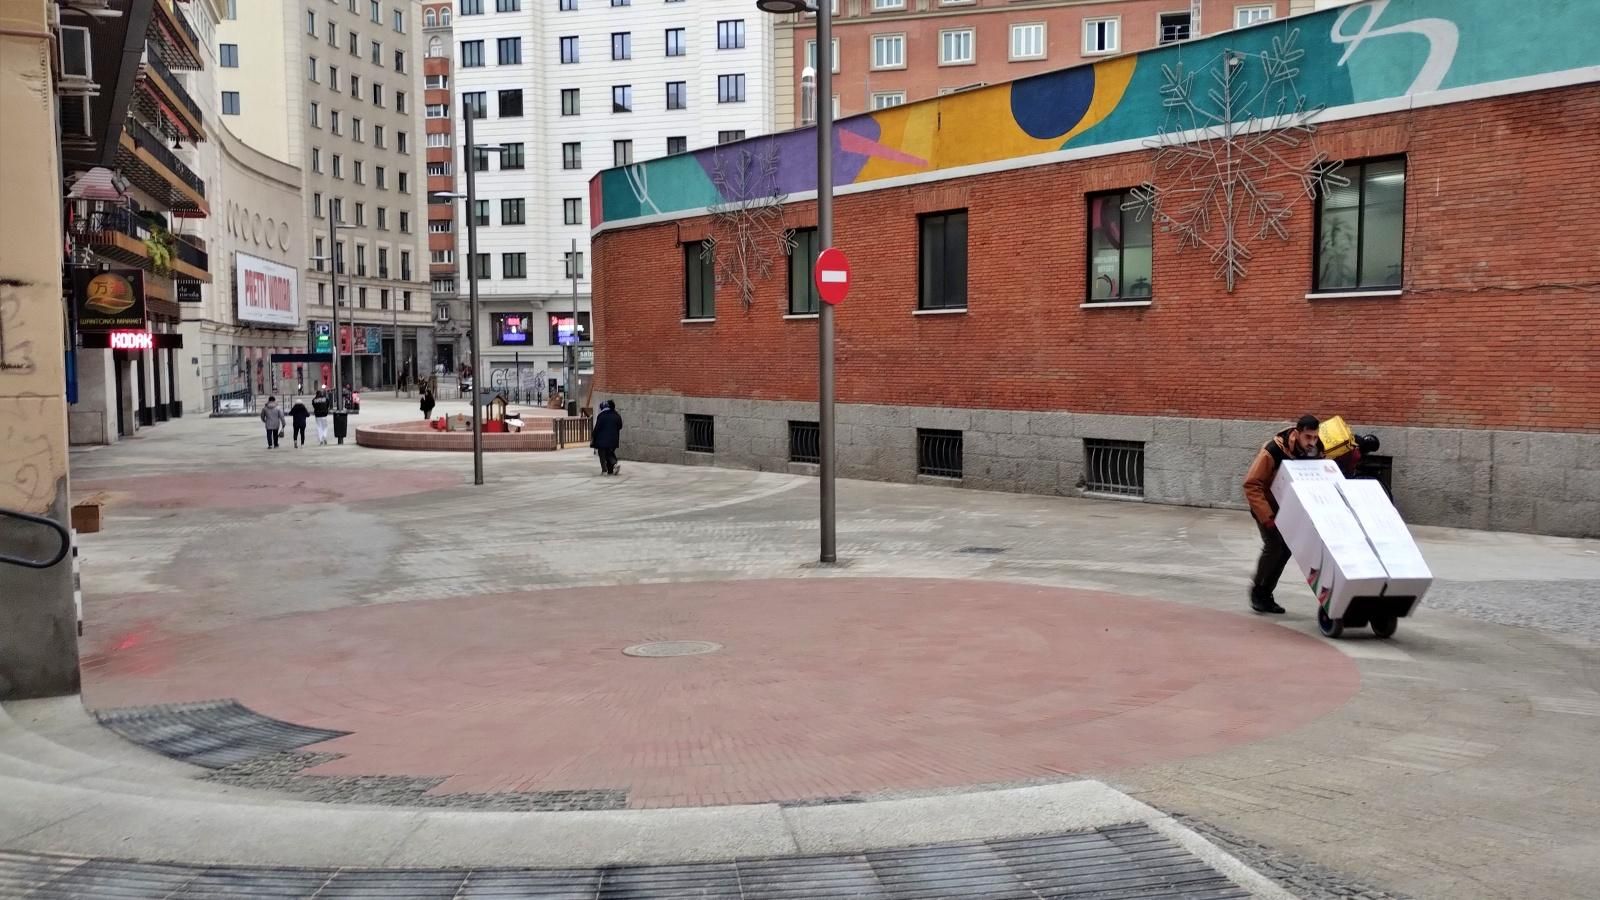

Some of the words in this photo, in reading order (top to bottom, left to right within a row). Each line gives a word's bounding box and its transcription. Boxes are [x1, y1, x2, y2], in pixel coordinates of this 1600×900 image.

[244, 269, 266, 309] PRETTY
[320, 325, 329, 335] P
[111, 332, 153, 349] KODAK
